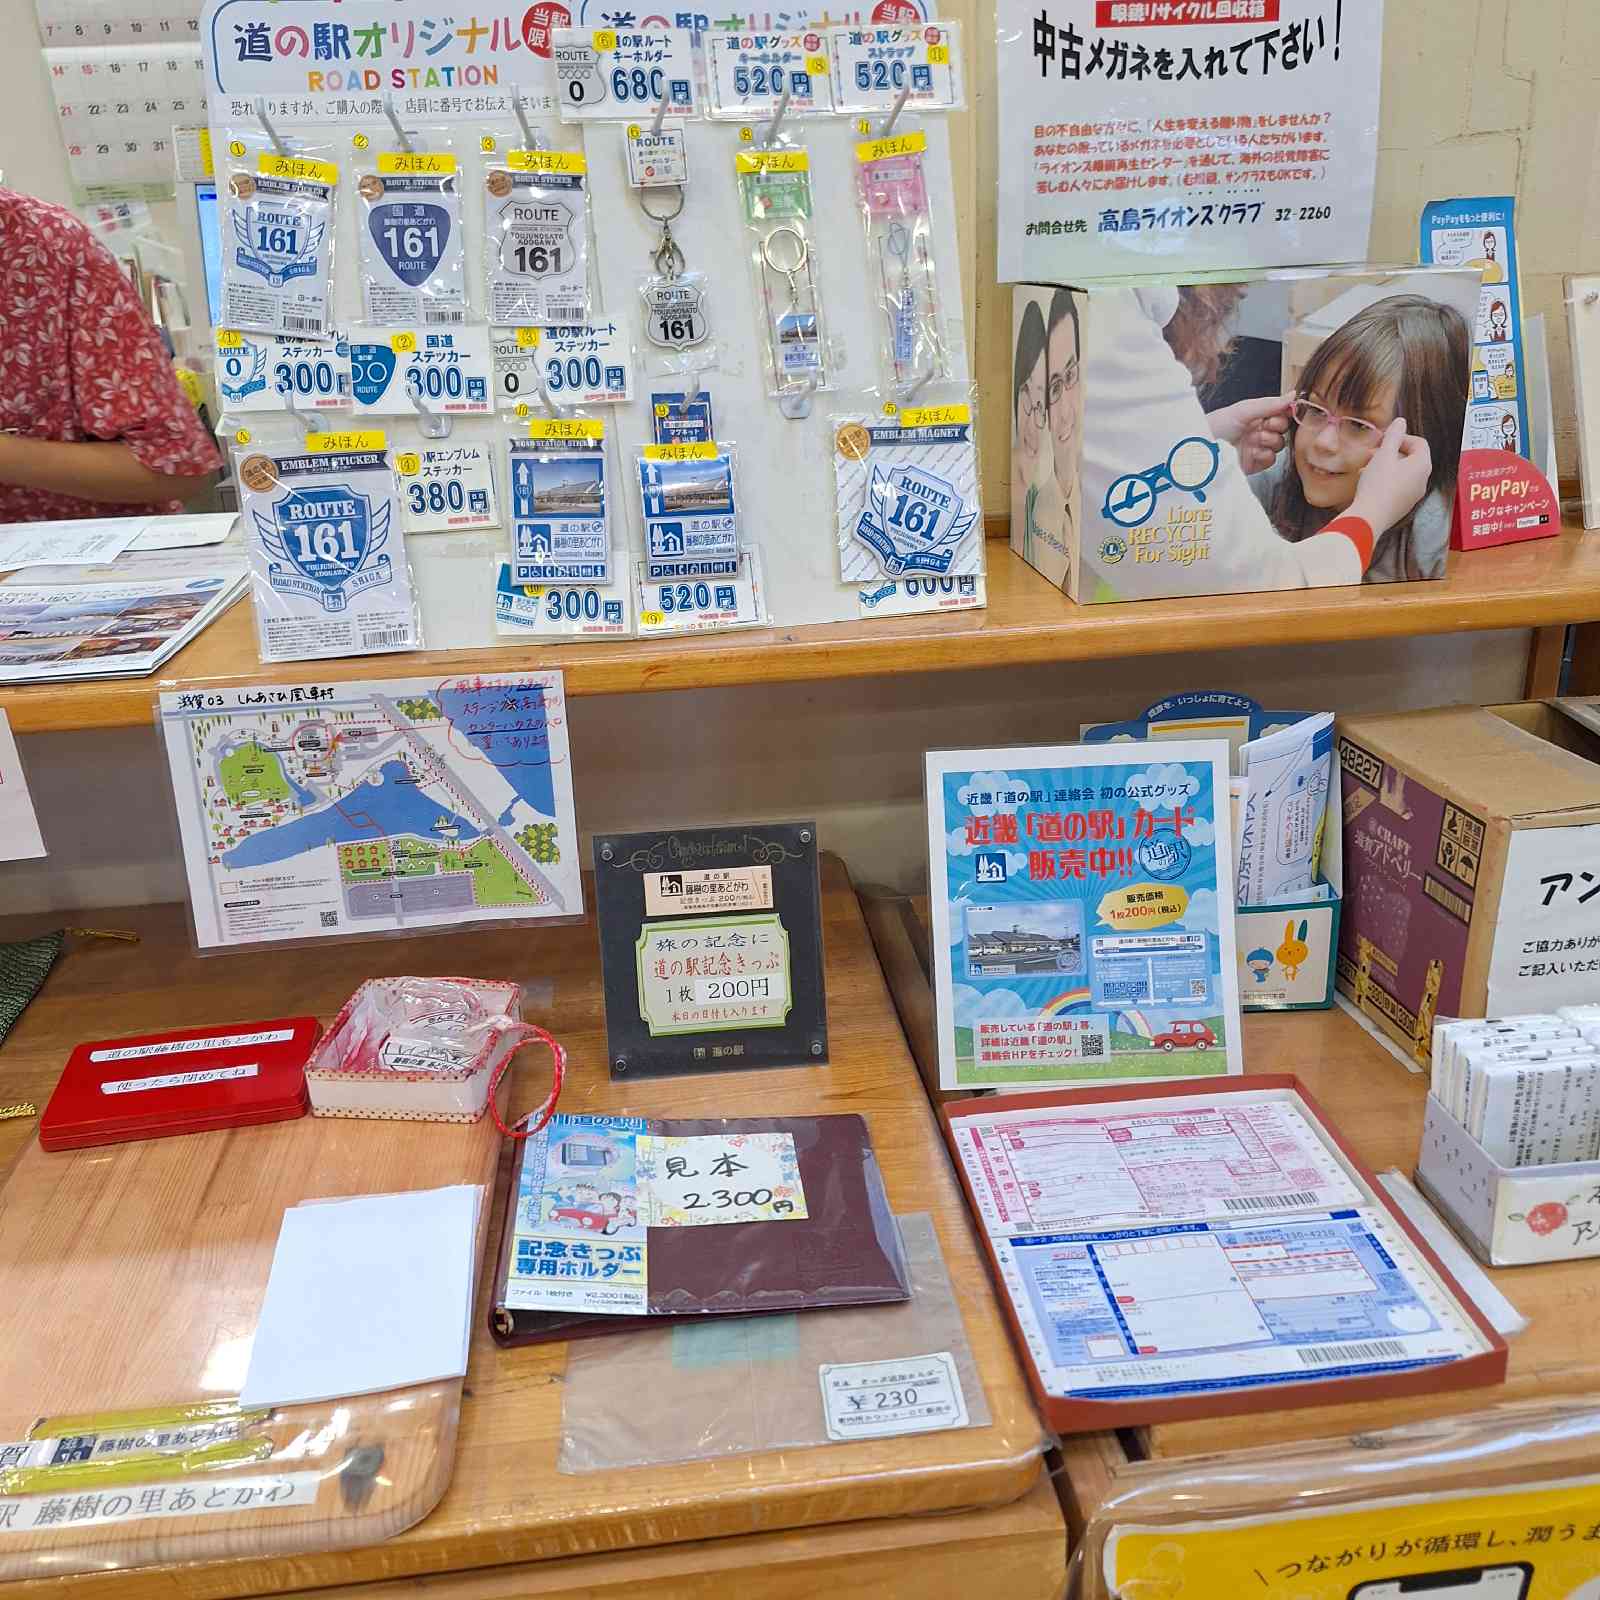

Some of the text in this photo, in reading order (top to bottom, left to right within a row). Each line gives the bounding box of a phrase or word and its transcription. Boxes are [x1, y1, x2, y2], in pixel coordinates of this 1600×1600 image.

[1111, 0, 1265, 23] 眼鏡リサイクル回収箱
[233, 16, 521, 62] 道の駅オリジナル
[528, 27, 553, 48] 限
[726, 34, 801, 49] 道の駅グッズ
[848, 30, 921, 46] 道の駅グッズ
[612, 50, 672, 62] キーホルダー
[866, 46, 916, 59] ストラップ
[308, 65, 497, 91] ROAD STATION
[733, 65, 812, 98] 520円
[855, 60, 933, 91] 520円
[569, 81, 585, 101] 0
[636, 136, 675, 148] ROUTE
[872, 141, 913, 156] みほん
[275, 160, 323, 179] みほん
[394, 157, 440, 171] みほん
[524, 153, 569, 170] みほん
[751, 155, 795, 169] みほん
[257, 211, 301, 226] ROUTE
[514, 209, 560, 221] ROUTE
[1025, 202, 1332, 236] お問合せ先 高島ライオンズクラブ 32-2260
[257, 226, 298, 255] 161
[383, 226, 439, 258] 161
[398, 261, 427, 271] ROUTE
[514, 247, 561, 273] 161
[657, 290, 690, 301] ROUTE
[546, 323, 617, 339] 道の駅ルート
[660, 319, 694, 340] 161
[426, 335, 453, 348] 国道
[555, 341, 610, 353] ステッカー
[282, 347, 333, 358] ステッカー
[412, 351, 471, 363] ステッカー
[226, 358, 242, 376] 0
[546, 355, 627, 391] 300円
[406, 365, 488, 401] 300円
[504, 373, 520, 393] 0
[545, 422, 588, 437] みほん
[873, 427, 960, 441] EMBLEM MAGNET
[323, 434, 369, 448] みほん
[281, 454, 379, 470] EMBLEM STICKER
[659, 445, 702, 459] みほん
[423, 464, 473, 477] ステッカー
[408, 480, 489, 514] 380円
[900, 476, 952, 508] ROUTE
[1470, 480, 1530, 502] PayPay
[289, 500, 355, 520] ROUTE
[888, 494, 941, 542] 161
[1167, 504, 1212, 525] Lions
[1471, 500, 1550, 520] おトクなキャンペーン
[295, 521, 360, 563] 161
[1128, 524, 1211, 545] RECYCLE
[1135, 543, 1209, 567] For Sight
[546, 588, 624, 624] 300円
[659, 583, 738, 612] 520円
[178, 693, 205, 710] 滋賀
[207, 696, 225, 706] 03
[1340, 745, 1381, 783] 48227
[966, 782, 1191, 806] 近畿「道の駅」連絡会 初の公式グッズ
[964, 806, 1196, 846] 近畿「道の駅」カード
[1126, 891, 1164, 904] 販売価格
[656, 932, 769, 952] 旅の記念に
[653, 952, 781, 980] 道の駅記念きっぷ
[665, 978, 769, 1005] 1枚 200円
[981, 1035, 1073, 1048] 詳細は近畿「道の駅」
[666, 1152, 748, 1180] 見本
[518, 1239, 641, 1263] 記念きっぷ
[516, 1259, 641, 1278] 専用ホルダー
[875, 1388, 918, 1409] 230
